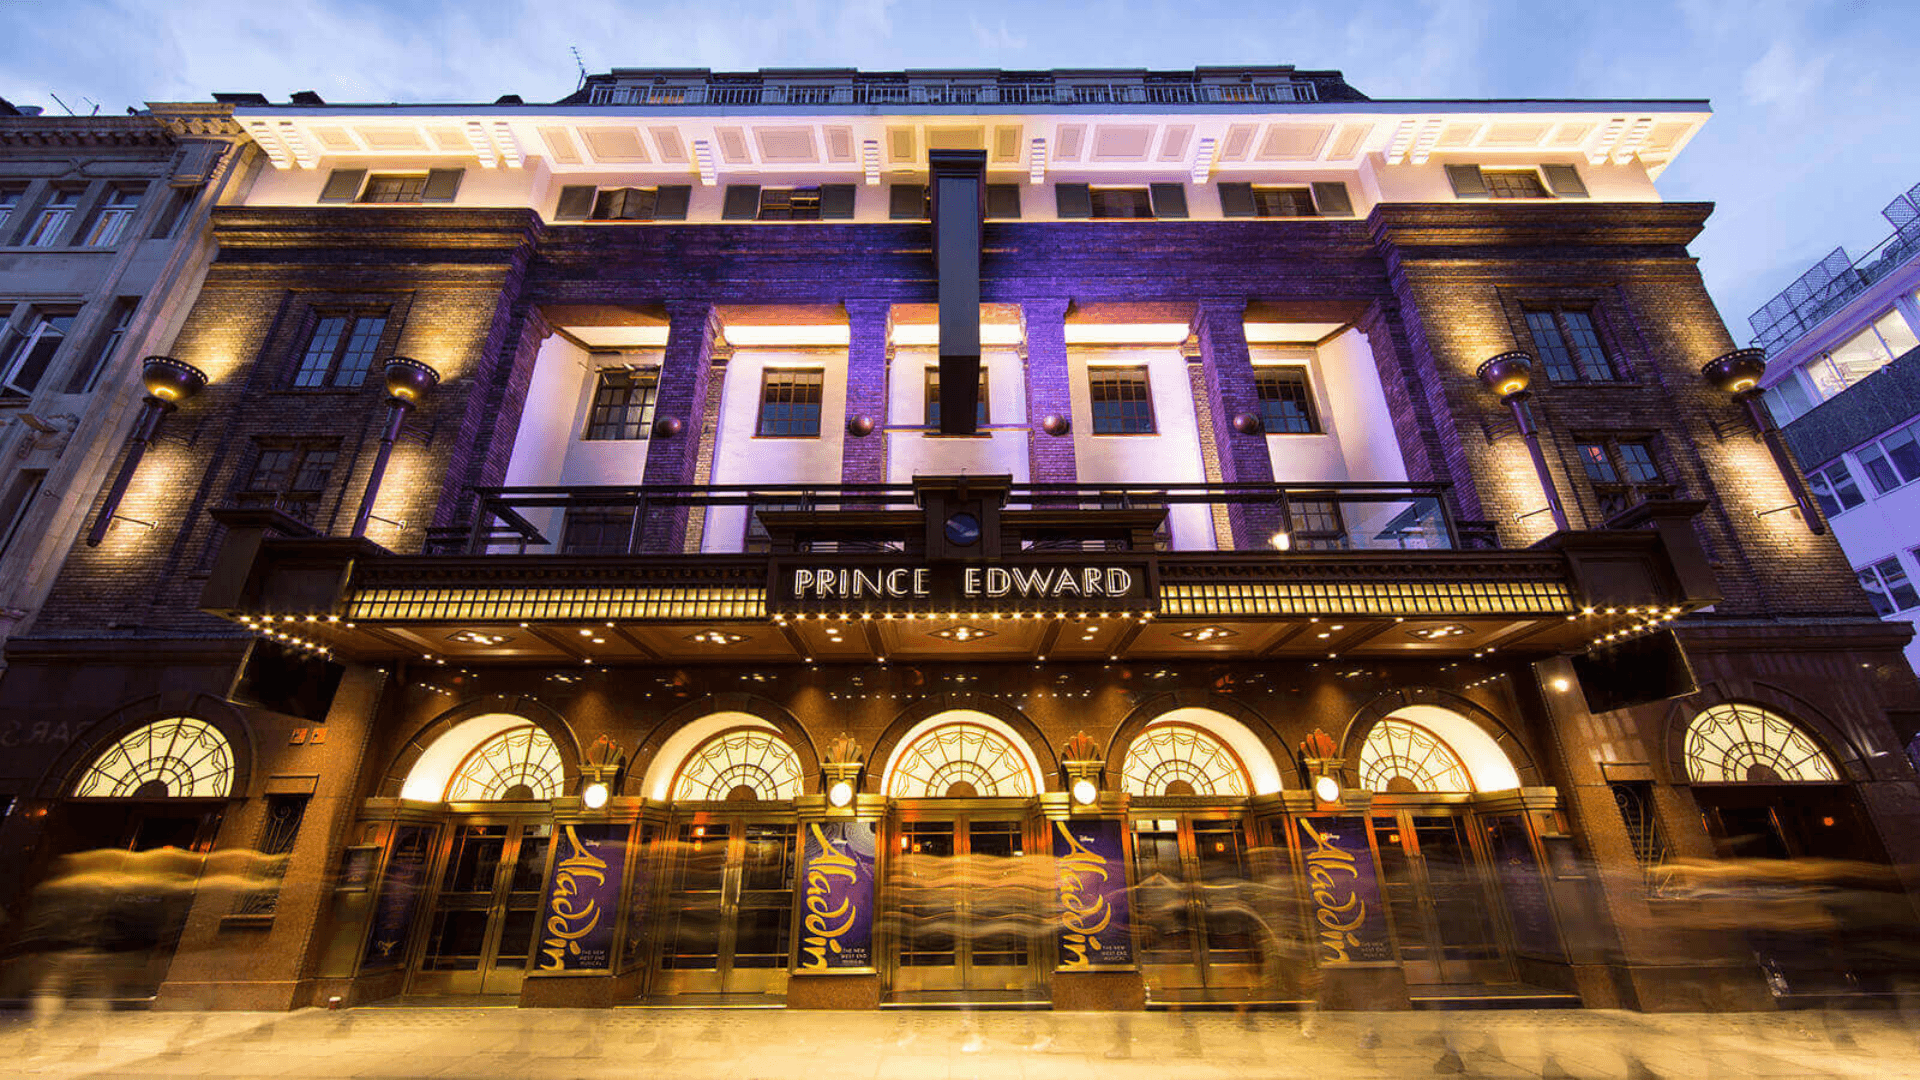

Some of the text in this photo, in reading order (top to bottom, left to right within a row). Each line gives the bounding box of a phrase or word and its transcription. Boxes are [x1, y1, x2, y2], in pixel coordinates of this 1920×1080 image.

[793, 567, 1132, 598] PRINCE EDWARD
[540, 825, 607, 970] Aladdin
[802, 823, 858, 969] Aladdin
[1056, 821, 1112, 965] Aladdin
[1300, 817, 1366, 962] Aladdin
